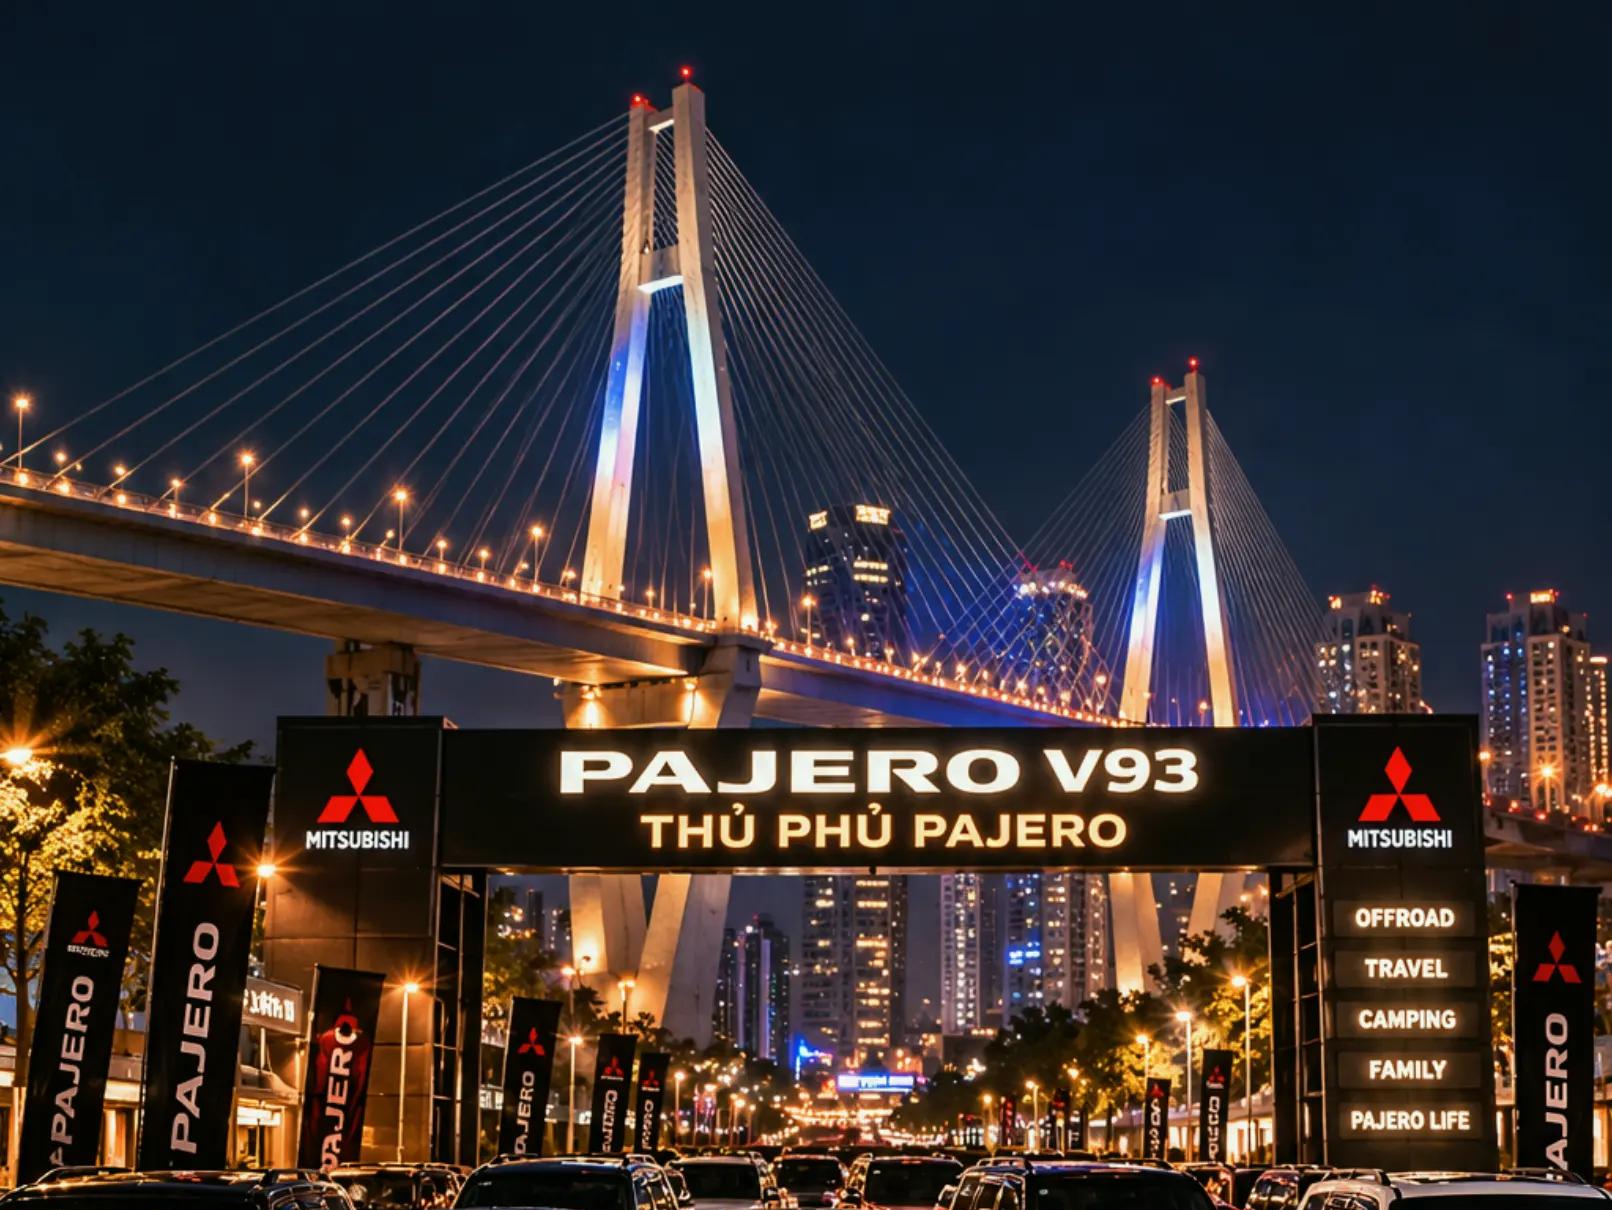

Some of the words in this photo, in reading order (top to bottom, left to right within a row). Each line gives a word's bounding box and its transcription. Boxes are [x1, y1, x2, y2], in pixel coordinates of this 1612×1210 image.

[559, 749, 1021, 795] PAJERO
[1042, 748, 1200, 794] V93
[640, 802, 756, 850] THỦ
[778, 802, 893, 850] PHỦ
[914, 813, 1128, 849] PAJERO
[305, 830, 410, 850] MITSUBISHI
[1347, 829, 1453, 849] MITSUBISHI
[1354, 907, 1456, 929] OFFROAD
[1364, 957, 1449, 979] TRAVEL
[1358, 1008, 1457, 1030] CAMPING
[171, 922, 220, 1154] PAJERO
[1368, 1059, 1448, 1080] FAMILY
[1545, 1012, 1569, 1171] AJERO
[1350, 1109, 1424, 1131] PAJERO
[1429, 1110, 1471, 1131] LIFE
